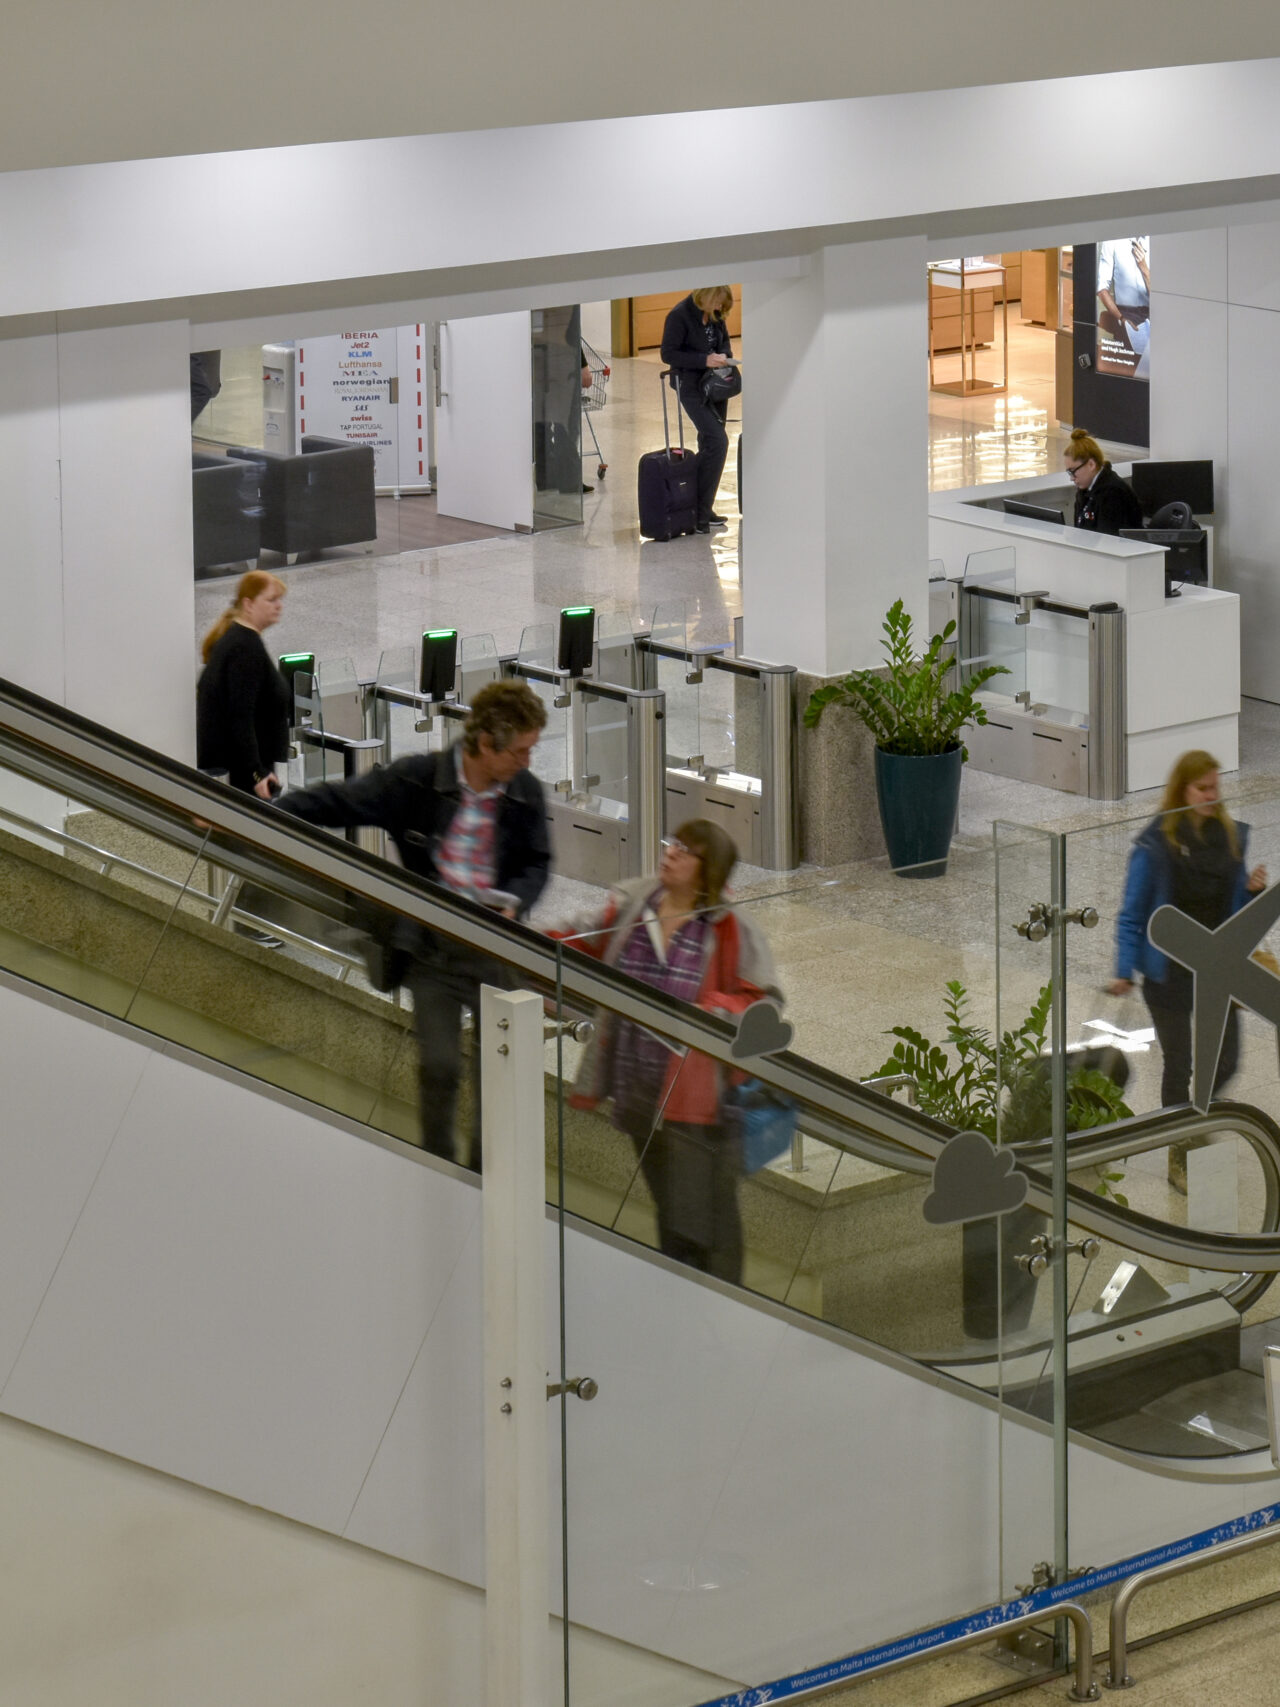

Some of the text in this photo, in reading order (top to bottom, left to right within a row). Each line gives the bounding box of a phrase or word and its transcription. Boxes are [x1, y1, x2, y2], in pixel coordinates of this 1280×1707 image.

[341, 332, 379, 340] IBERIA
[338, 361, 382, 369] Lufthansa
[332, 378, 391, 386] norwegian
[350, 414, 373, 422] swiss
[1051, 1541, 1193, 1599] Welcome to Malta International Airport
[791, 1631, 945, 1689] Welcome to Malta International Airport
